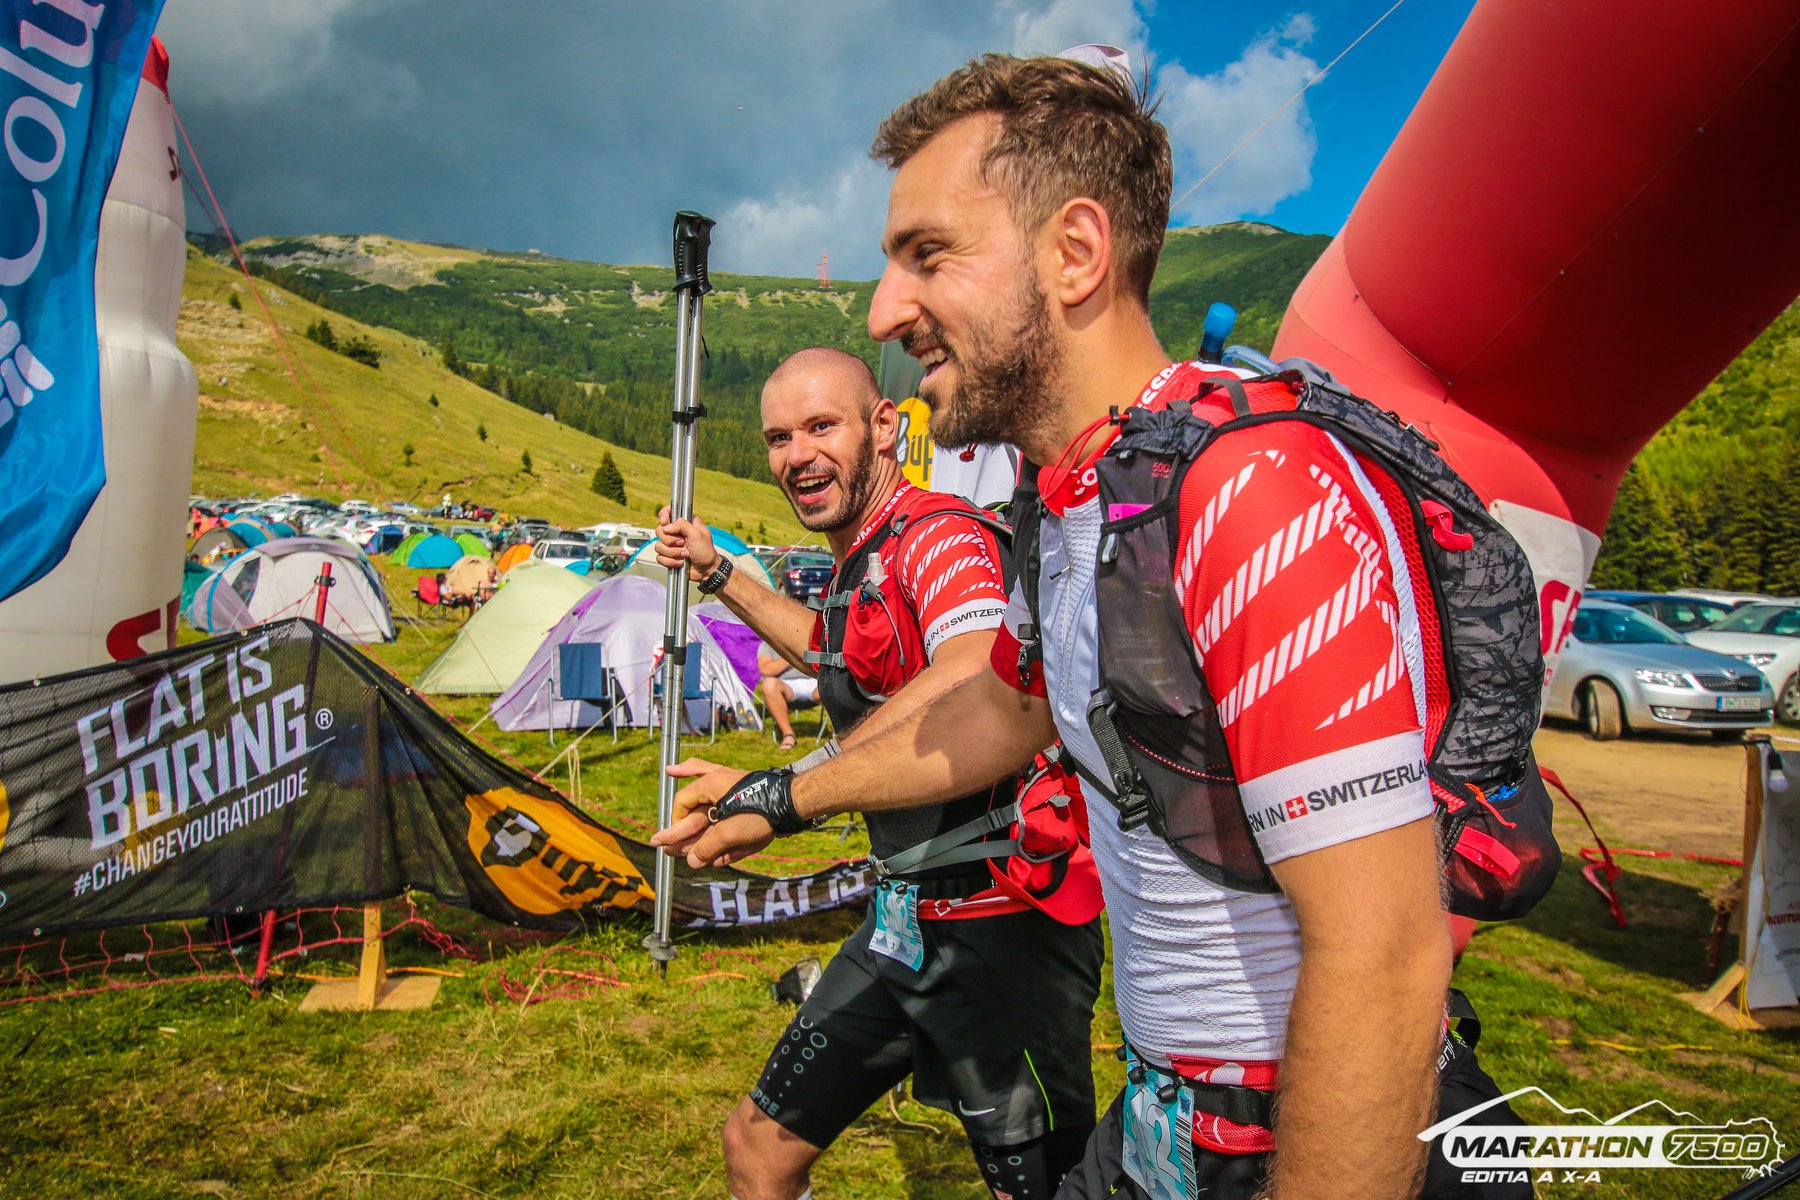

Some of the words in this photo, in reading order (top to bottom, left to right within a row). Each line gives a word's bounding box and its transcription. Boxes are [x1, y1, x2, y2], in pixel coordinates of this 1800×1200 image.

[950, 607, 1005, 626] SWITZER
[77, 653, 216, 776] FLAT
[226, 635, 272, 704] IS
[740, 777, 769, 801] LEKI
[1265, 803, 1287, 827] IN
[1307, 757, 1428, 812] SWITZERLA
[74, 767, 308, 896] #CHANGEYOURATTITUDE
[692, 878, 814, 923] FLAT
[1436, 1034, 1456, 1074] enji
